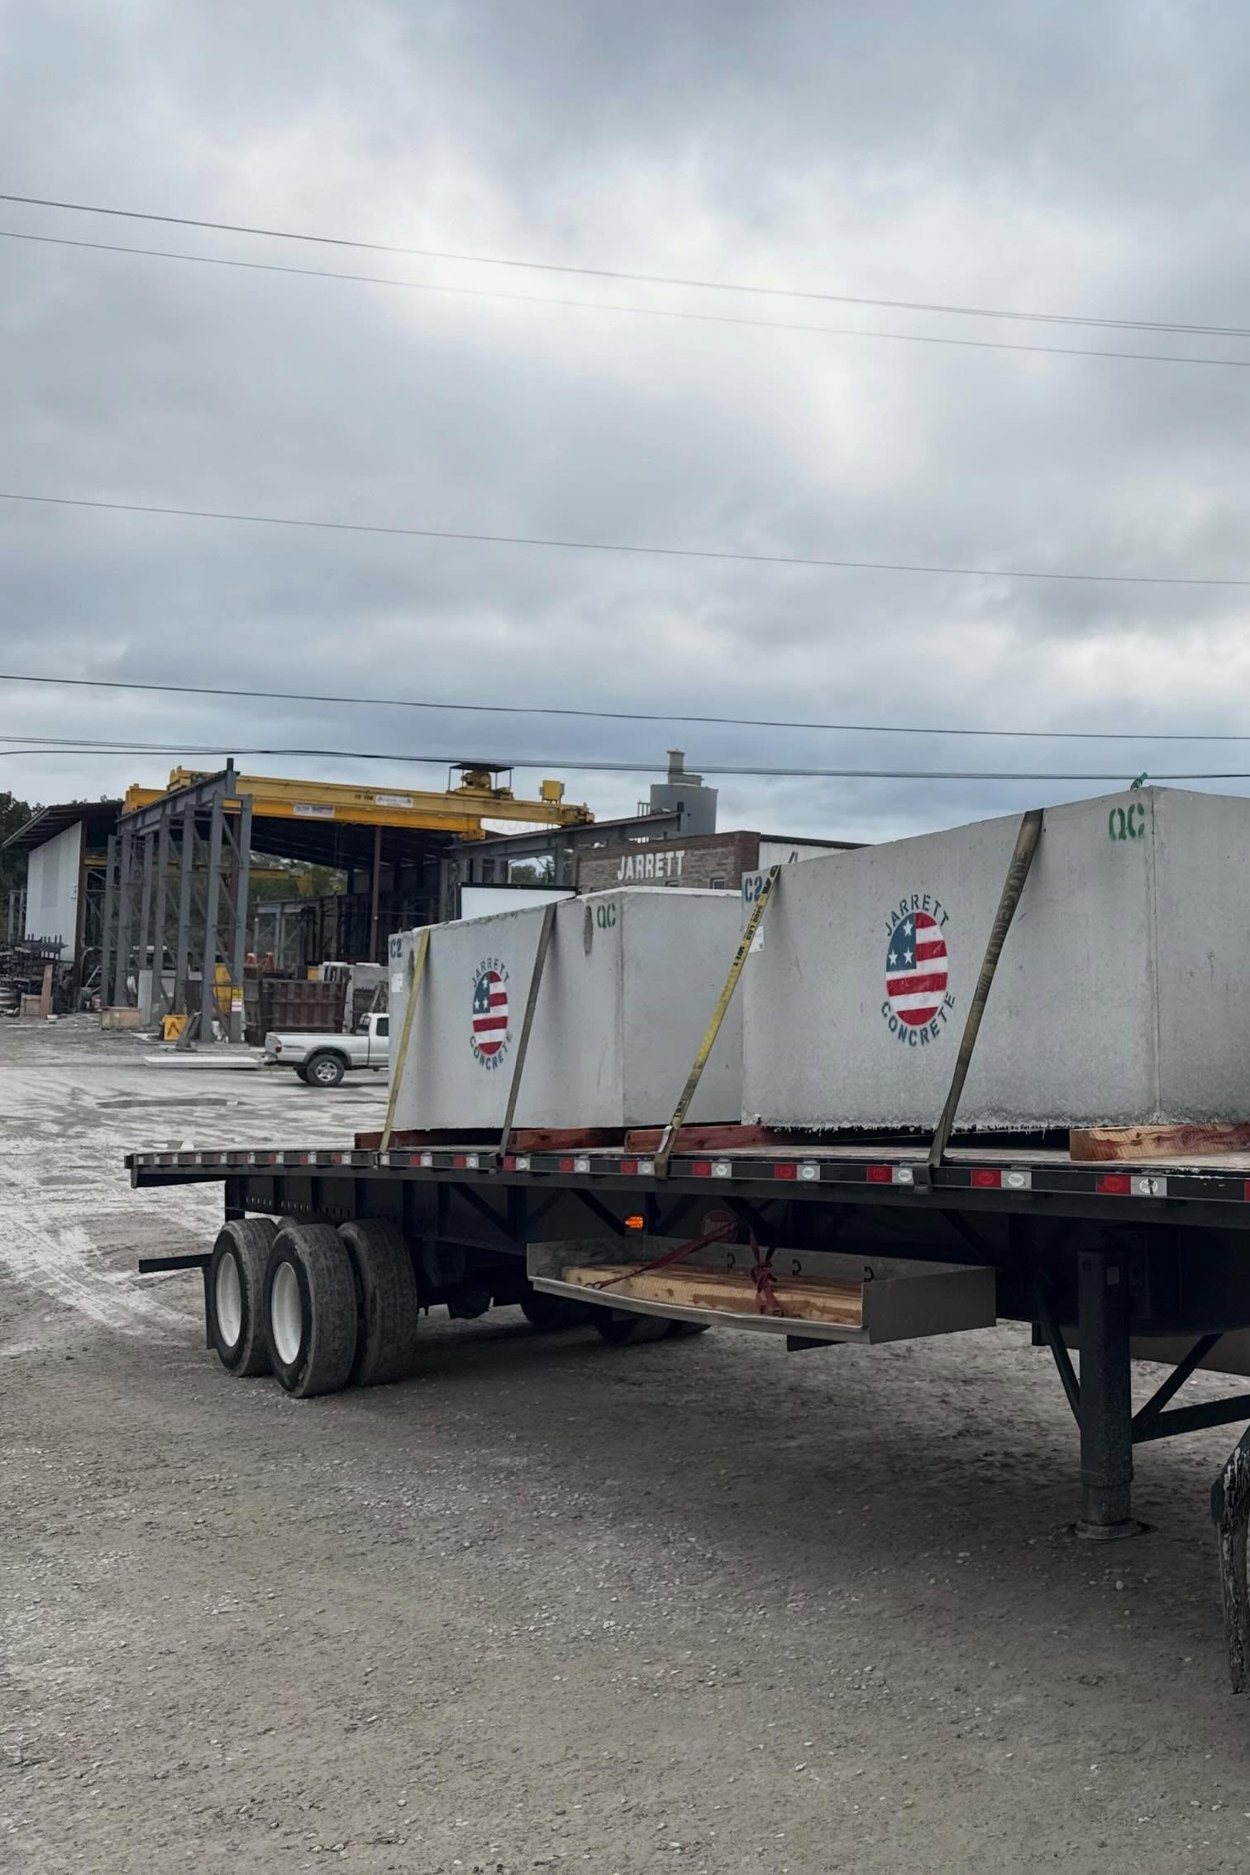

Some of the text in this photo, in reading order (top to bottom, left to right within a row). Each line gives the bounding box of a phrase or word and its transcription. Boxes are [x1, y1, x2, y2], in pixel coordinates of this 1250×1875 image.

[617, 850, 686, 881] JARRETT
[885, 894, 950, 937] JARRETT
[472, 957, 510, 988] JARRETT
[881, 992, 955, 1048] CONCRETE
[470, 1031, 513, 1071] CONCRETE
